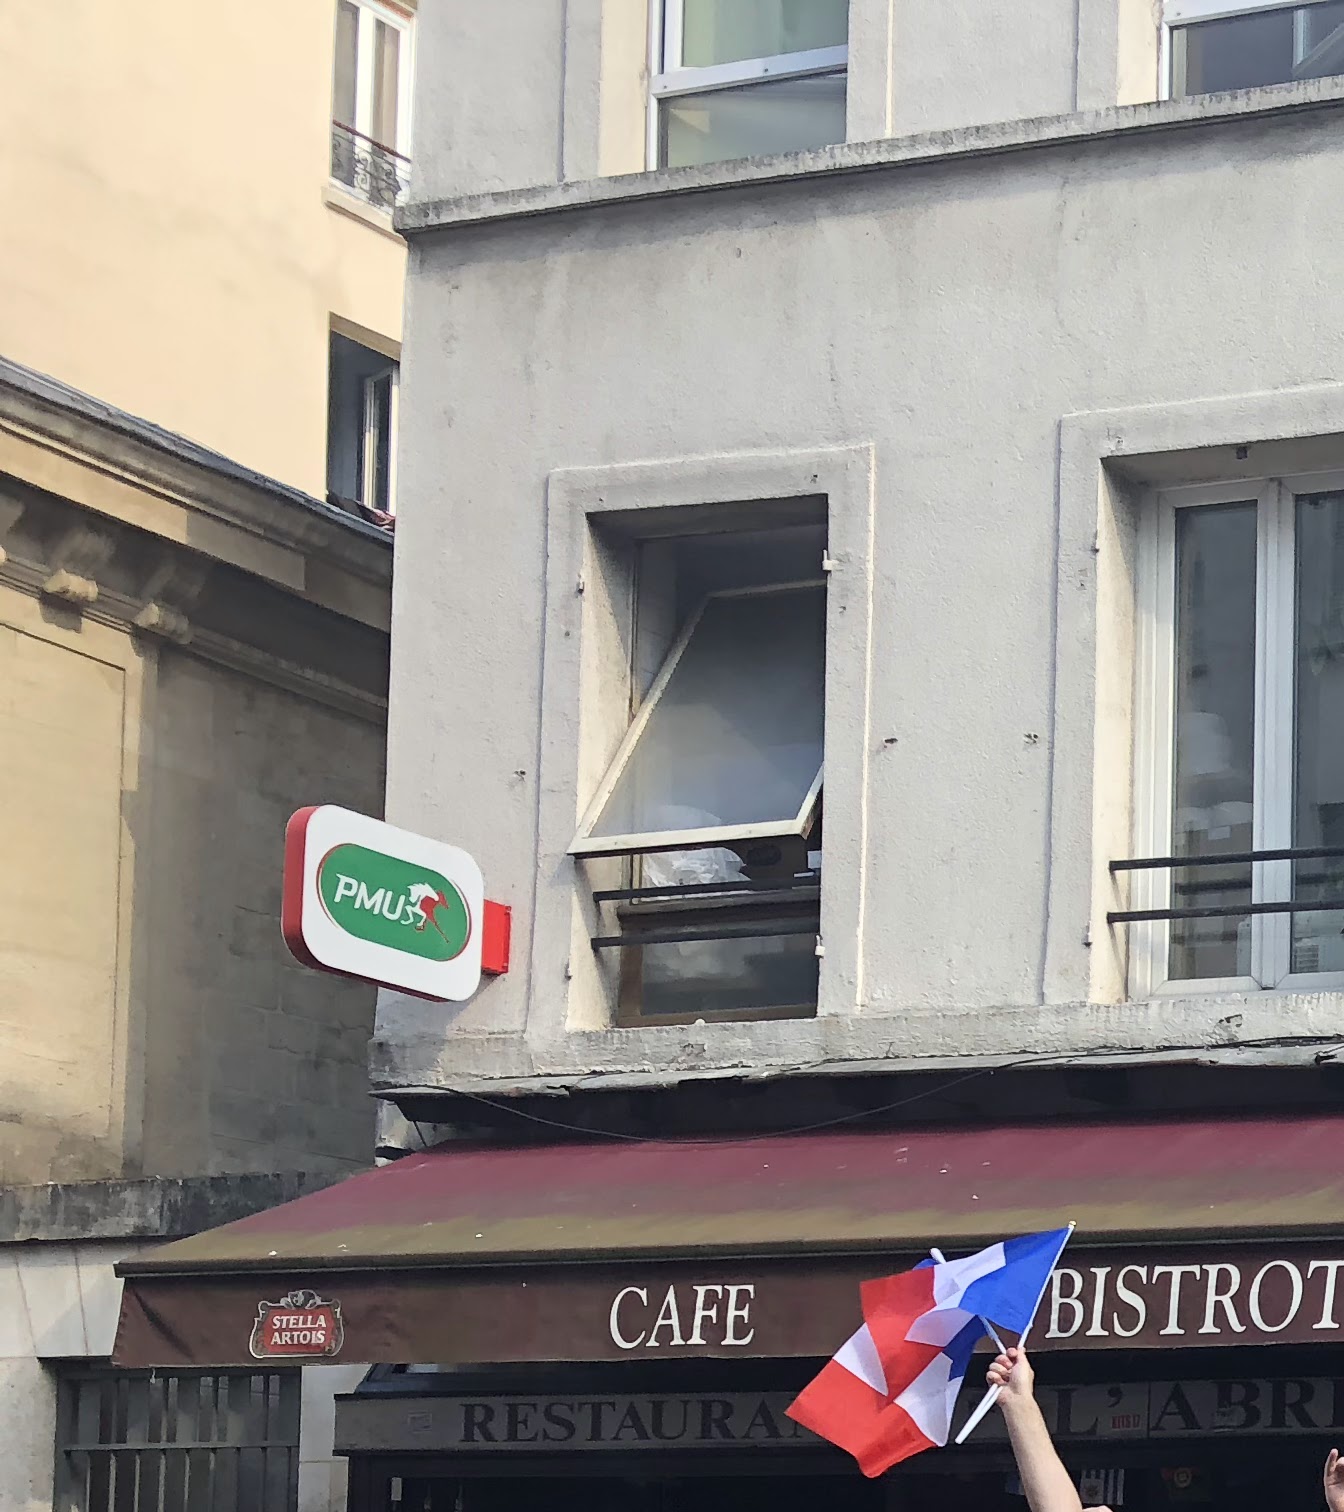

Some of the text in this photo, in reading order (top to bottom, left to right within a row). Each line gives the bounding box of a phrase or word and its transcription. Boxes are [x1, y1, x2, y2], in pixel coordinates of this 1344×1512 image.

[336, 873, 405, 921] PMU
[270, 1330, 326, 1345] ARTOIS
[272, 1314, 327, 1329] STELLA
[609, 1284, 755, 1350] CAFE
[459, 1398, 820, 1443] RESTAURA
